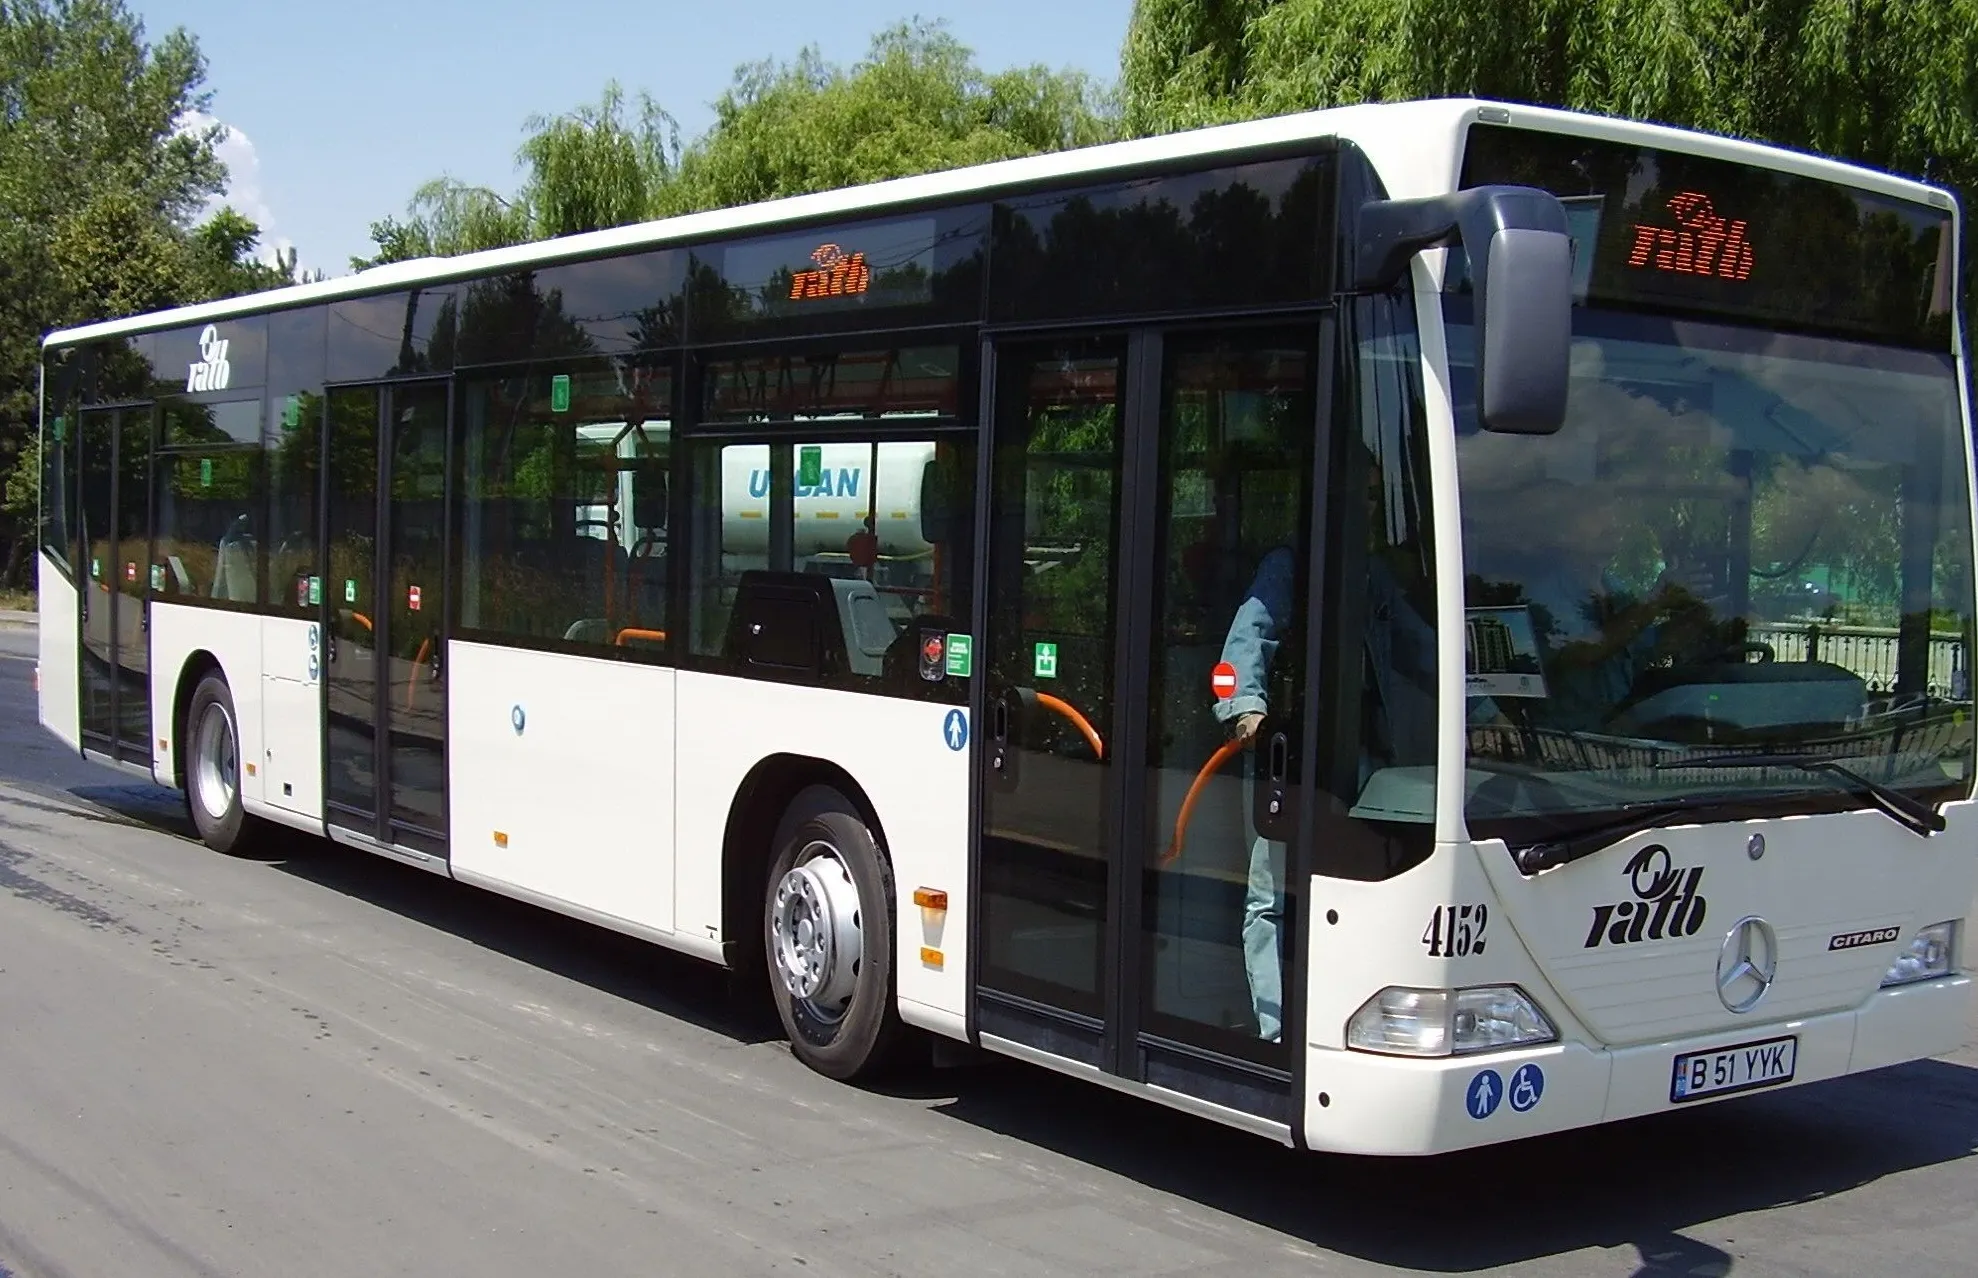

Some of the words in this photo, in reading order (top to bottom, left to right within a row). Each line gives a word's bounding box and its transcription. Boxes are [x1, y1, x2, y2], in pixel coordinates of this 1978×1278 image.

[1421, 903, 1488, 957] 4152
[1583, 866, 1707, 948] ratb
[1832, 928, 1897, 948] CITARO
[1691, 1058, 1707, 1089] B
[1714, 1053, 1735, 1085] 51
[1745, 1044, 1787, 1079] YYK
